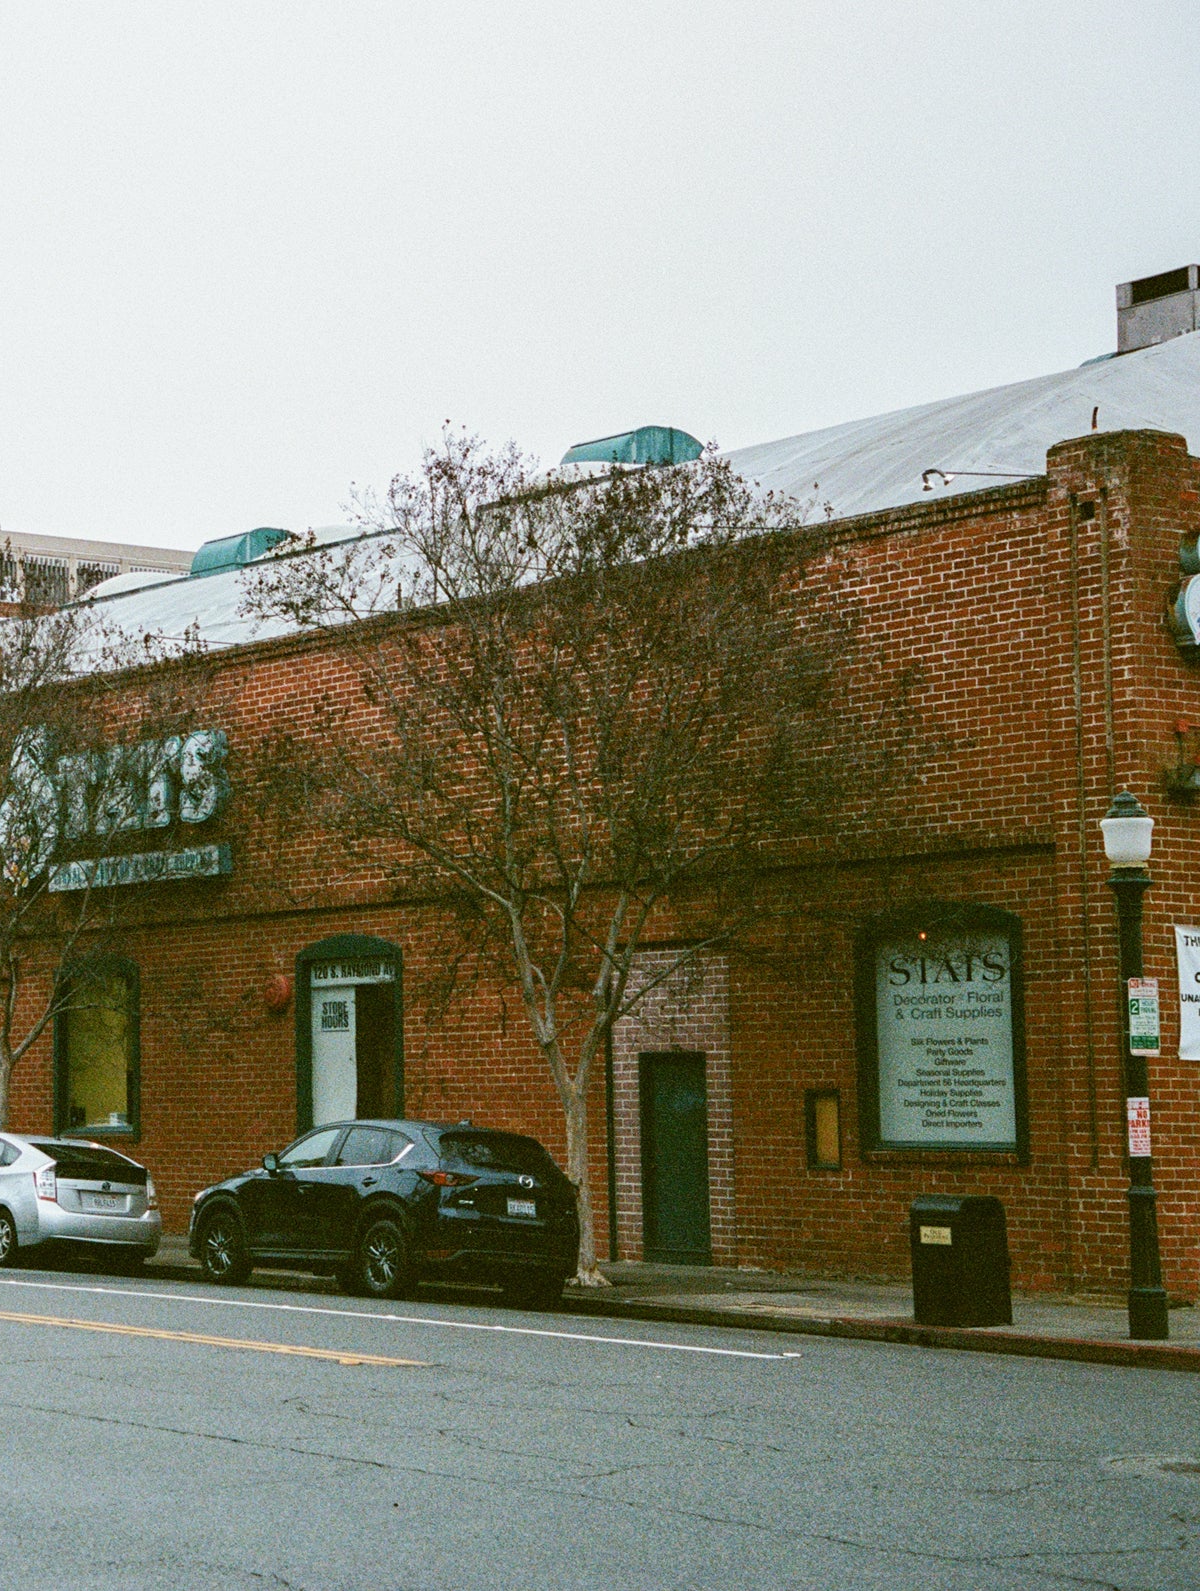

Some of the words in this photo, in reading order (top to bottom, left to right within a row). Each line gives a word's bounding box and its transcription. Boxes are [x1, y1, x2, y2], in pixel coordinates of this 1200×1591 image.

[893, 994, 956, 1007] Decorator
[966, 991, 1003, 1004] Floral
[322, 1001, 349, 1015] STORE
[1131, 1000, 1139, 1014] 2
[895, 1008, 905, 1019] &
[911, 1007, 942, 1020] Craft
[945, 1005, 1003, 1020] Supplies
[321, 1014, 349, 1029] HOURS
[926, 1037, 956, 1046] Flowers
[964, 1037, 989, 1046] Plants
[926, 1048, 946, 1057] Party
[947, 1048, 974, 1056] Goods
[916, 1068, 950, 1077] Seasonal
[951, 1068, 986, 1078] Supplies
[897, 1079, 941, 1088] Department
[953, 1078, 1007, 1088] Headquarters
[920, 1089, 948, 1098] Holiday
[949, 1088, 983, 1098] Supplies
[903, 1099, 941, 1109] Designing
[949, 1099, 968, 1107] Craft
[969, 1099, 1001, 1107] Classes
[925, 1109, 946, 1118] Dried
[947, 1109, 978, 1118] Flowers
[1136, 1110, 1147, 1119] NO
[921, 1119, 945, 1128] Direct
[945, 1119, 983, 1129] Importers
